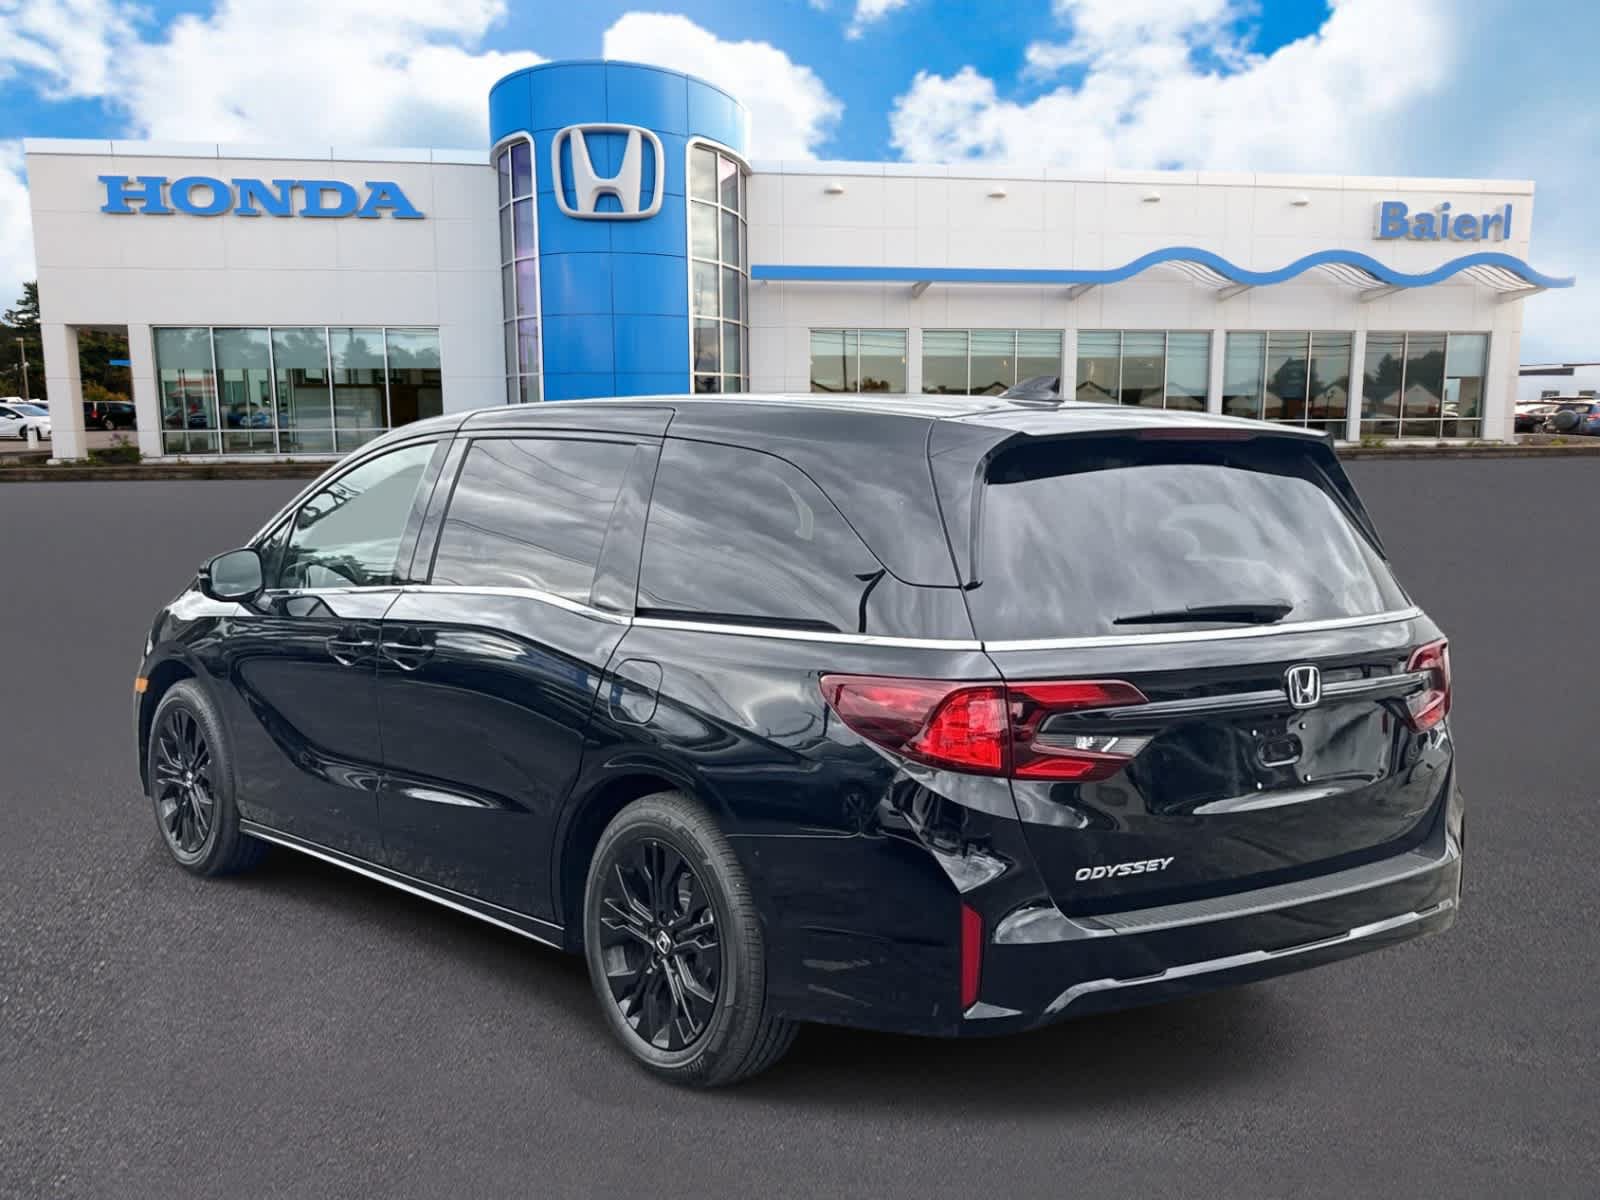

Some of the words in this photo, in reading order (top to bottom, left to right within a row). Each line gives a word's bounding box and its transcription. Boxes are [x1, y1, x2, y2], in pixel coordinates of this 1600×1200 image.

[98, 175, 424, 219] HONDA
[1379, 201, 1513, 240] Baierl
[1075, 856, 1175, 881] ODYSSEY
